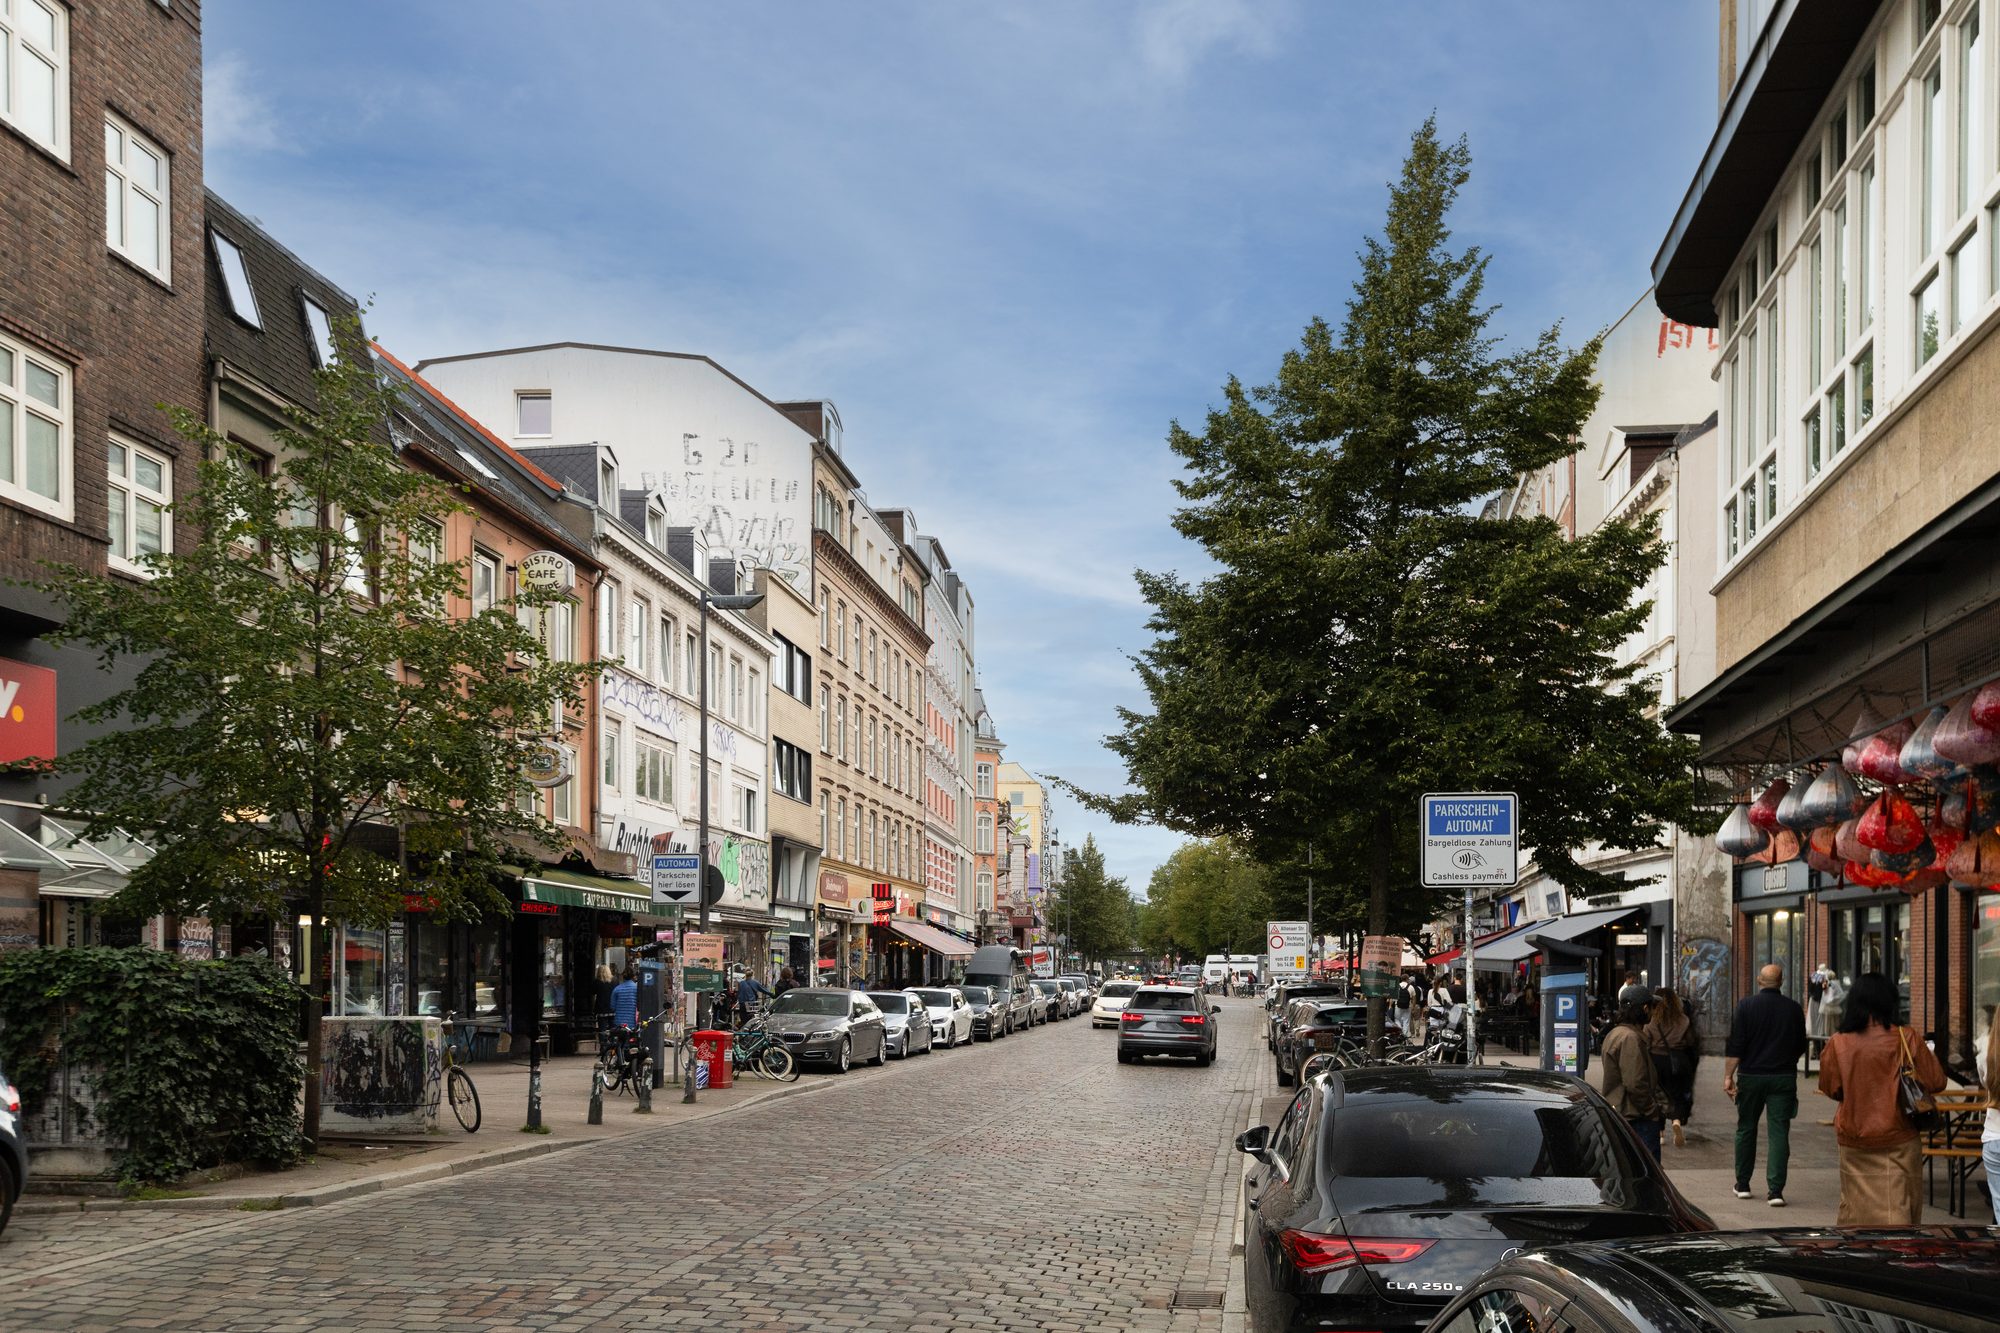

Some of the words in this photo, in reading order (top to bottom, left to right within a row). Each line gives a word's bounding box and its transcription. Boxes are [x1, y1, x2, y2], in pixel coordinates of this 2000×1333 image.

[522, 555, 563, 570] BISTRO
[528, 569, 556, 579] CAFE
[524, 580, 560, 592] KNEIPE
[1435, 804, 1506, 816] PARKSCHEIN-
[1446, 820, 1493, 832] AUTOMAT
[1428, 839, 1476, 848] Bargeldlose
[1480, 839, 1512, 847] Zahlung
[657, 860, 696, 868] AUTOMAT
[1432, 872, 1469, 880] Cashless
[1472, 873, 1507, 882] payment
[583, 892, 617, 909] TAVERNA
[621, 897, 650, 913] ROMANA
[644, 973, 653, 984] P
[1558, 997, 1574, 1017] P
[1386, 1281, 1418, 1291] CLA
